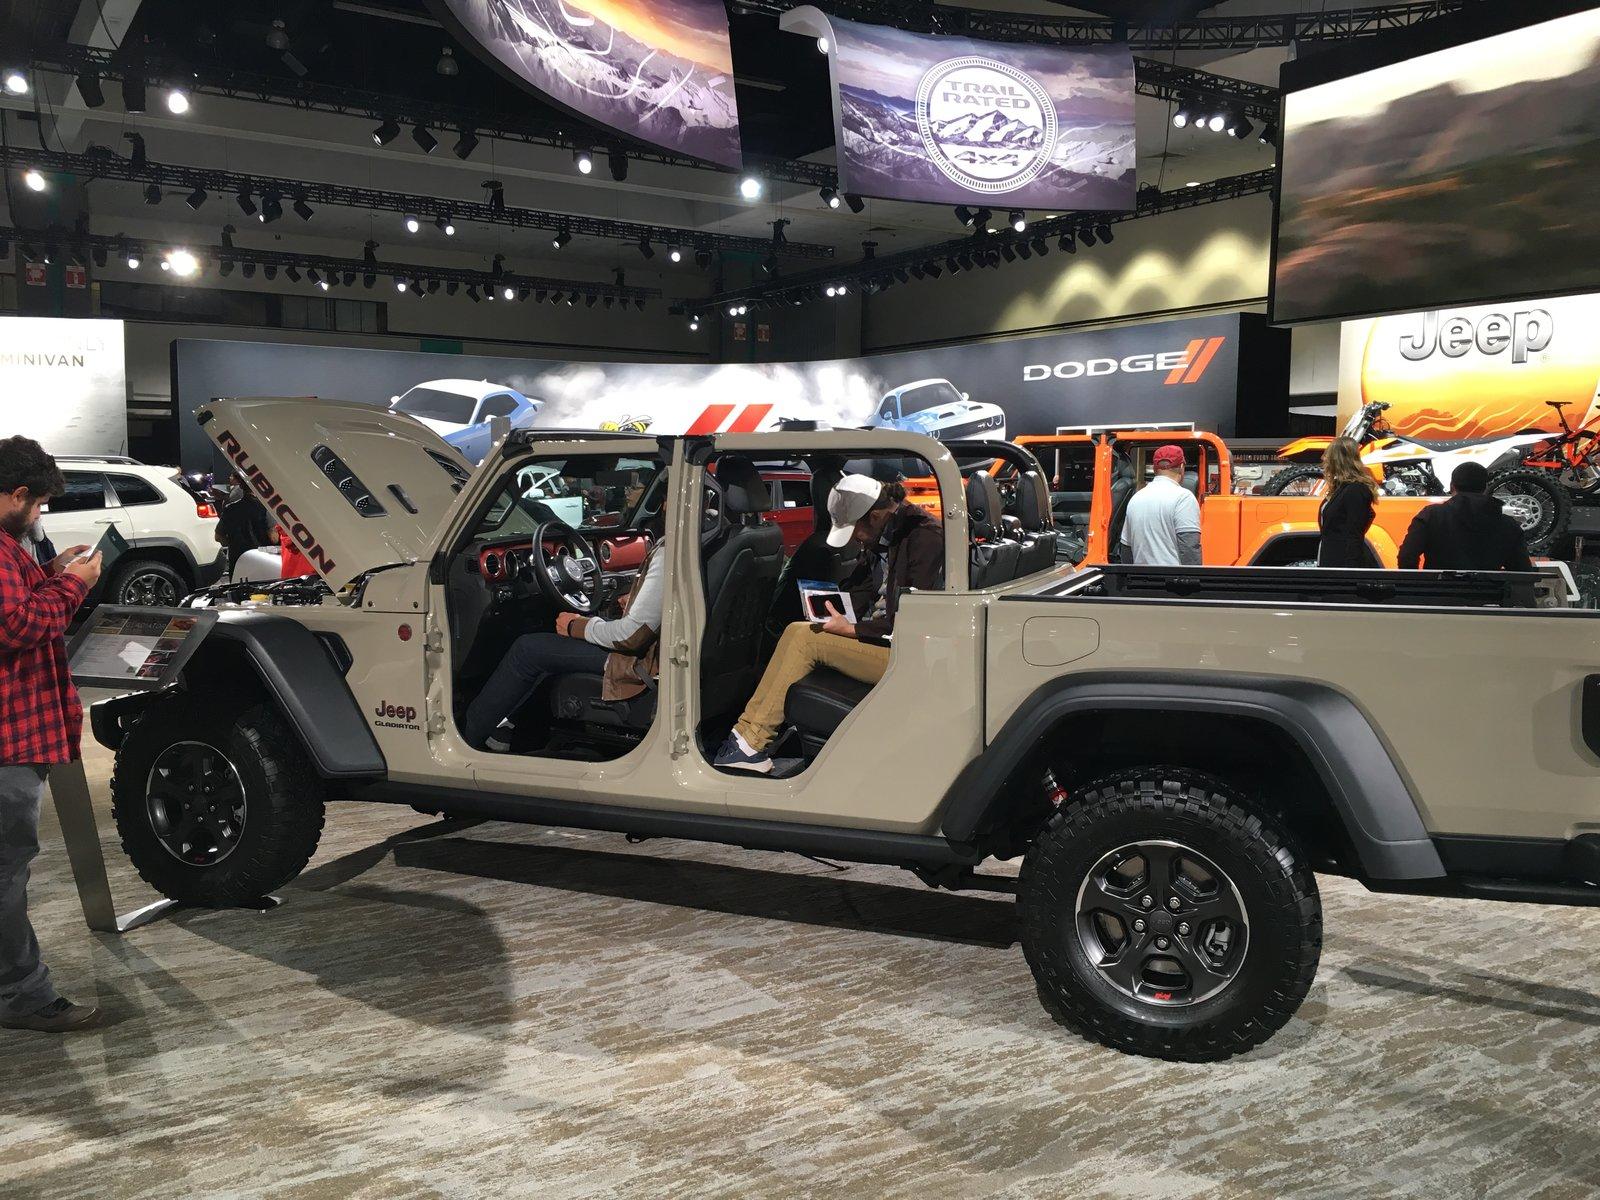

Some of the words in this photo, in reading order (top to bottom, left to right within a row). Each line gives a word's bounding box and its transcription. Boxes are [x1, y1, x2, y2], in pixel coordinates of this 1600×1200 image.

[945, 81, 1024, 97] TRAIL
[943, 92, 1031, 109] RATED
[1399, 308, 1554, 364] Jeep
[0, 354, 85, 368] MINIVAN
[1023, 351, 1190, 382] DODGE
[216, 430, 337, 575] RUBICON
[375, 700, 417, 722] Jeep
[375, 720, 421, 731] GLADIATOR
